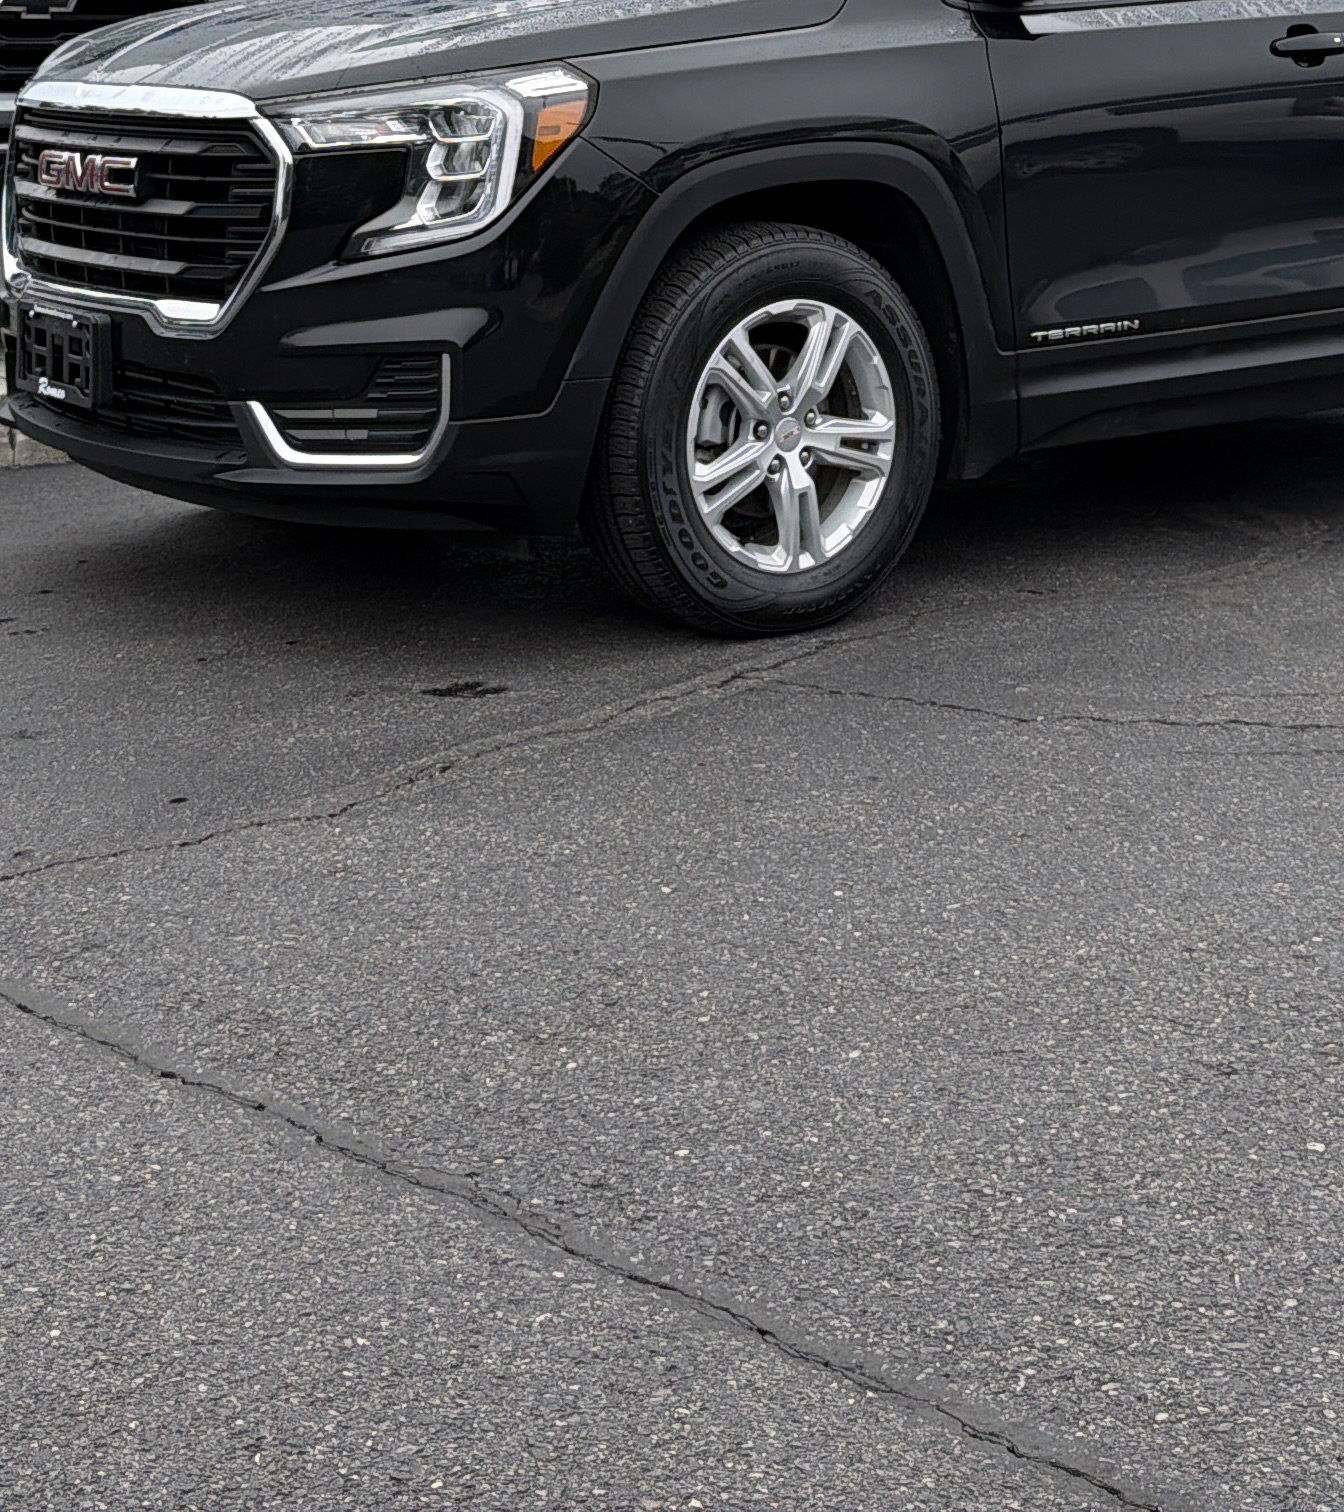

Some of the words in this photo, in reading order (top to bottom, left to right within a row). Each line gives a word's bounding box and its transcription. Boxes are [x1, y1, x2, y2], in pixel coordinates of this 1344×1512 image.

[37, 149, 138, 197] GMC
[1030, 319, 1140, 342] TERRAIN
[864, 289, 930, 463] ASSURA
